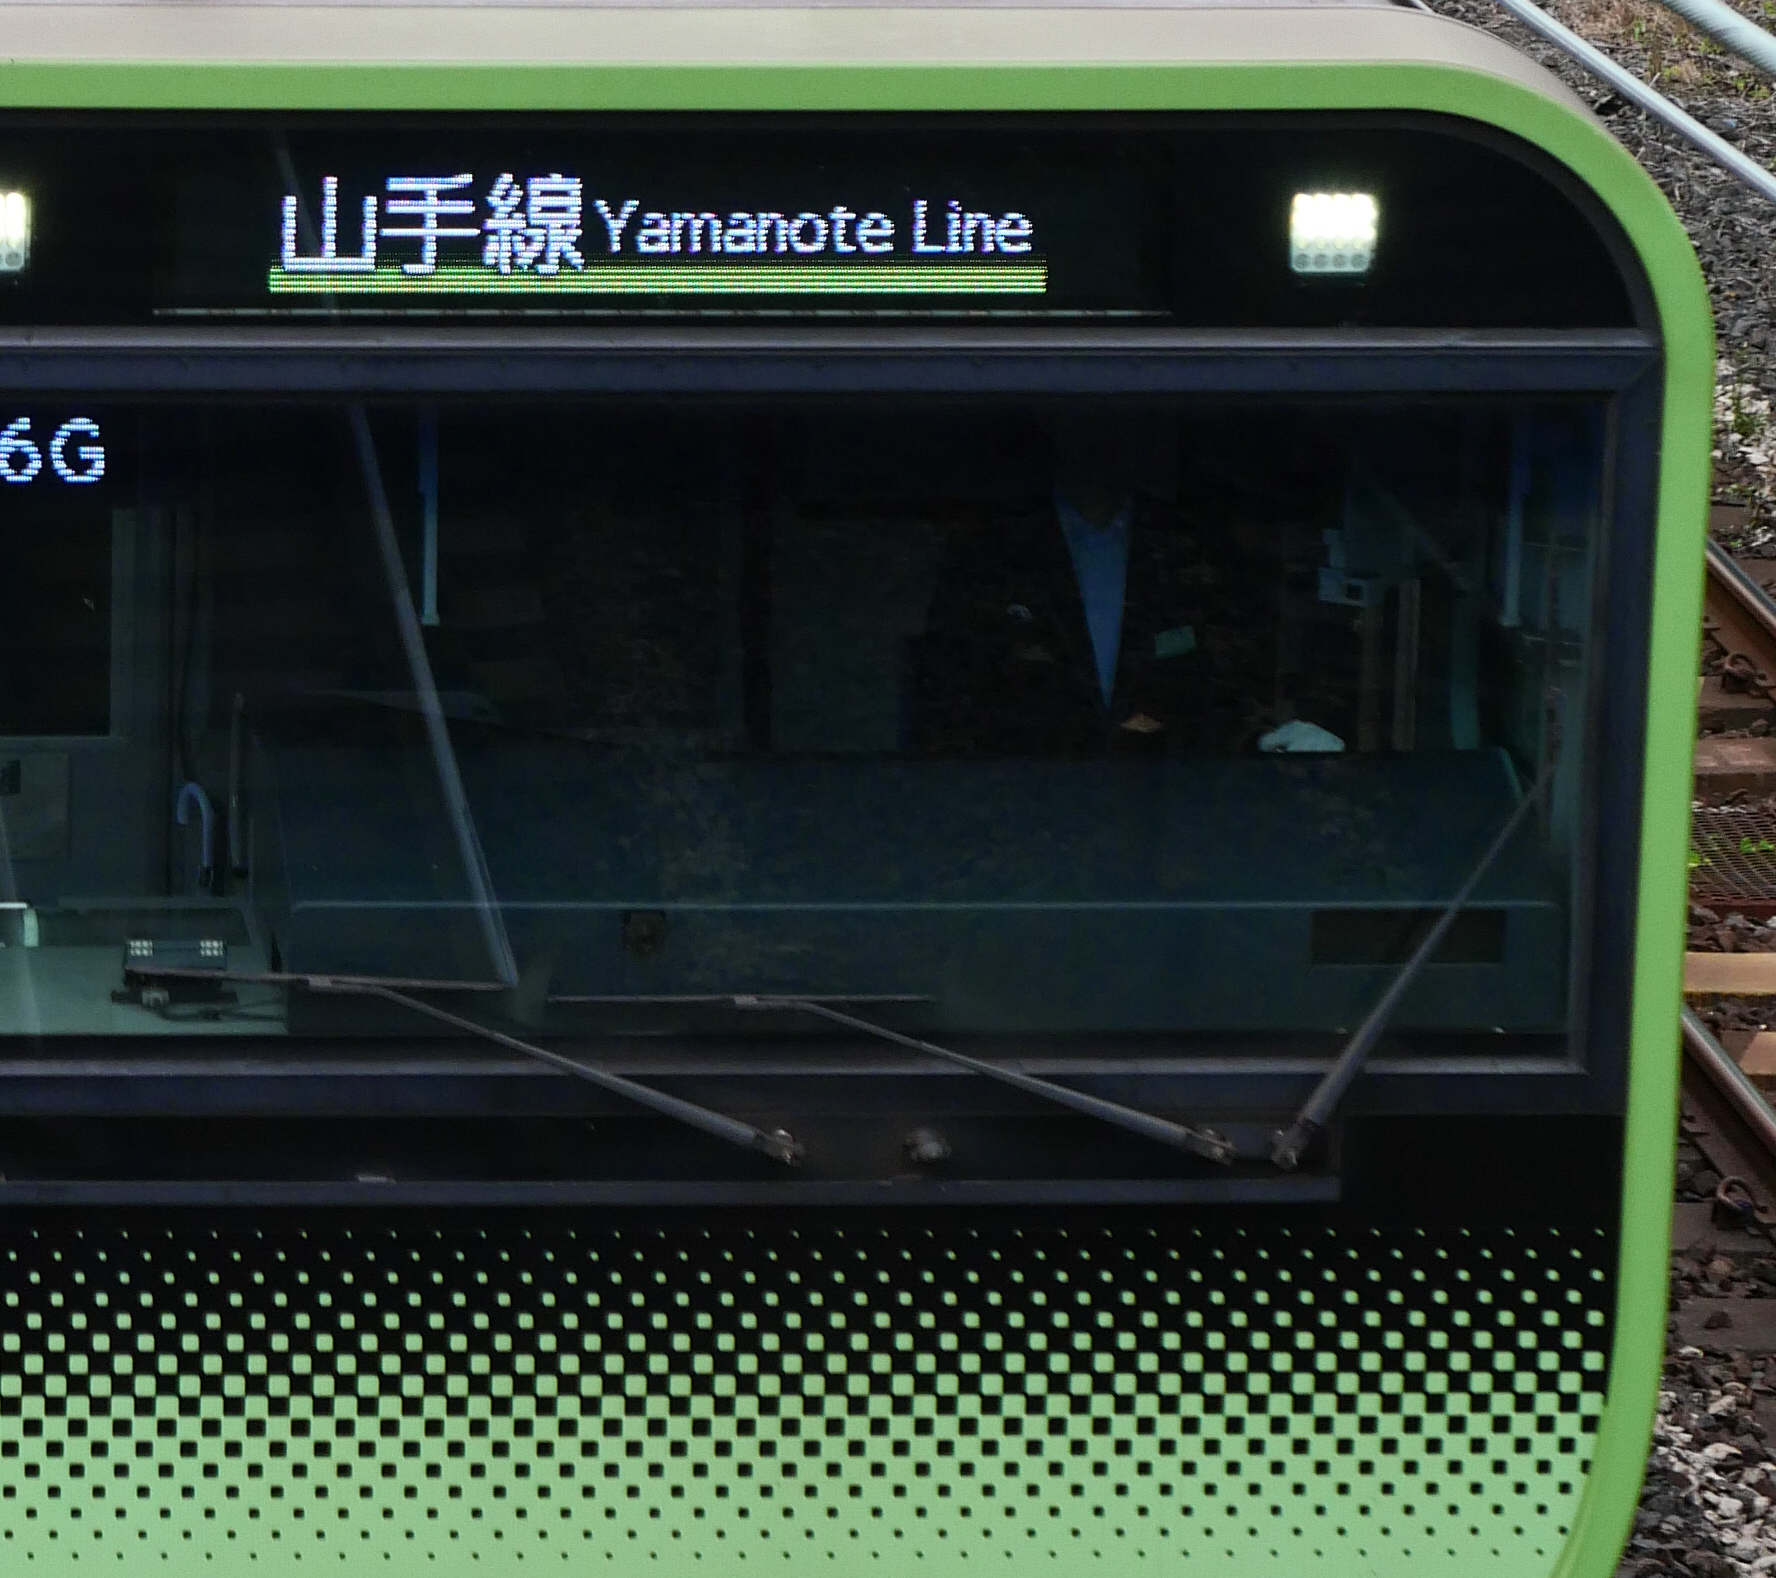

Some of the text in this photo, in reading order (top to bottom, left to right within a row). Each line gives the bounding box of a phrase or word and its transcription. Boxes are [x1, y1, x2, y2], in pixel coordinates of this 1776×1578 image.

[279, 172, 1035, 278] 山手線 Yamanote Line
